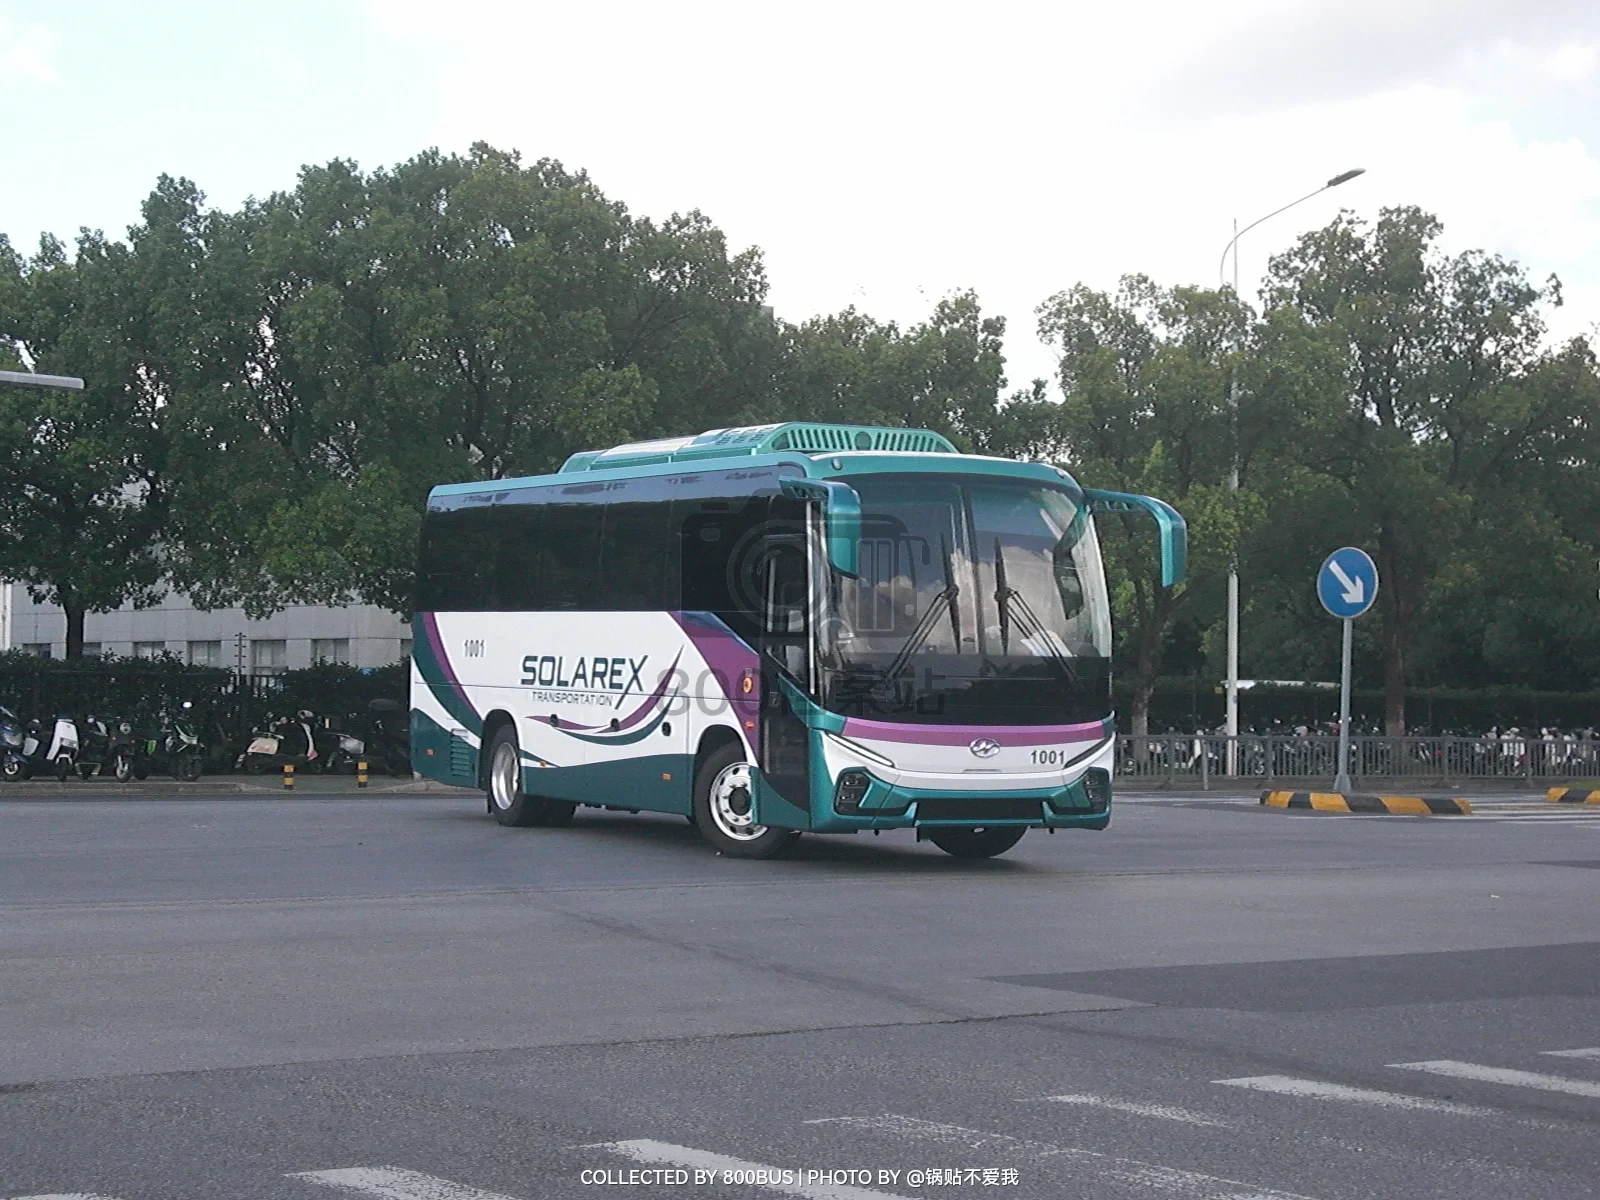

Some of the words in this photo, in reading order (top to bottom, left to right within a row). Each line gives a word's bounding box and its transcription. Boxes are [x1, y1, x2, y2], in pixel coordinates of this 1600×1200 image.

[464, 639, 485, 658] 1001
[520, 655, 649, 710] SOLAREX
[531, 691, 614, 707] TRANSPORTATION
[1030, 750, 1065, 765] 1001
